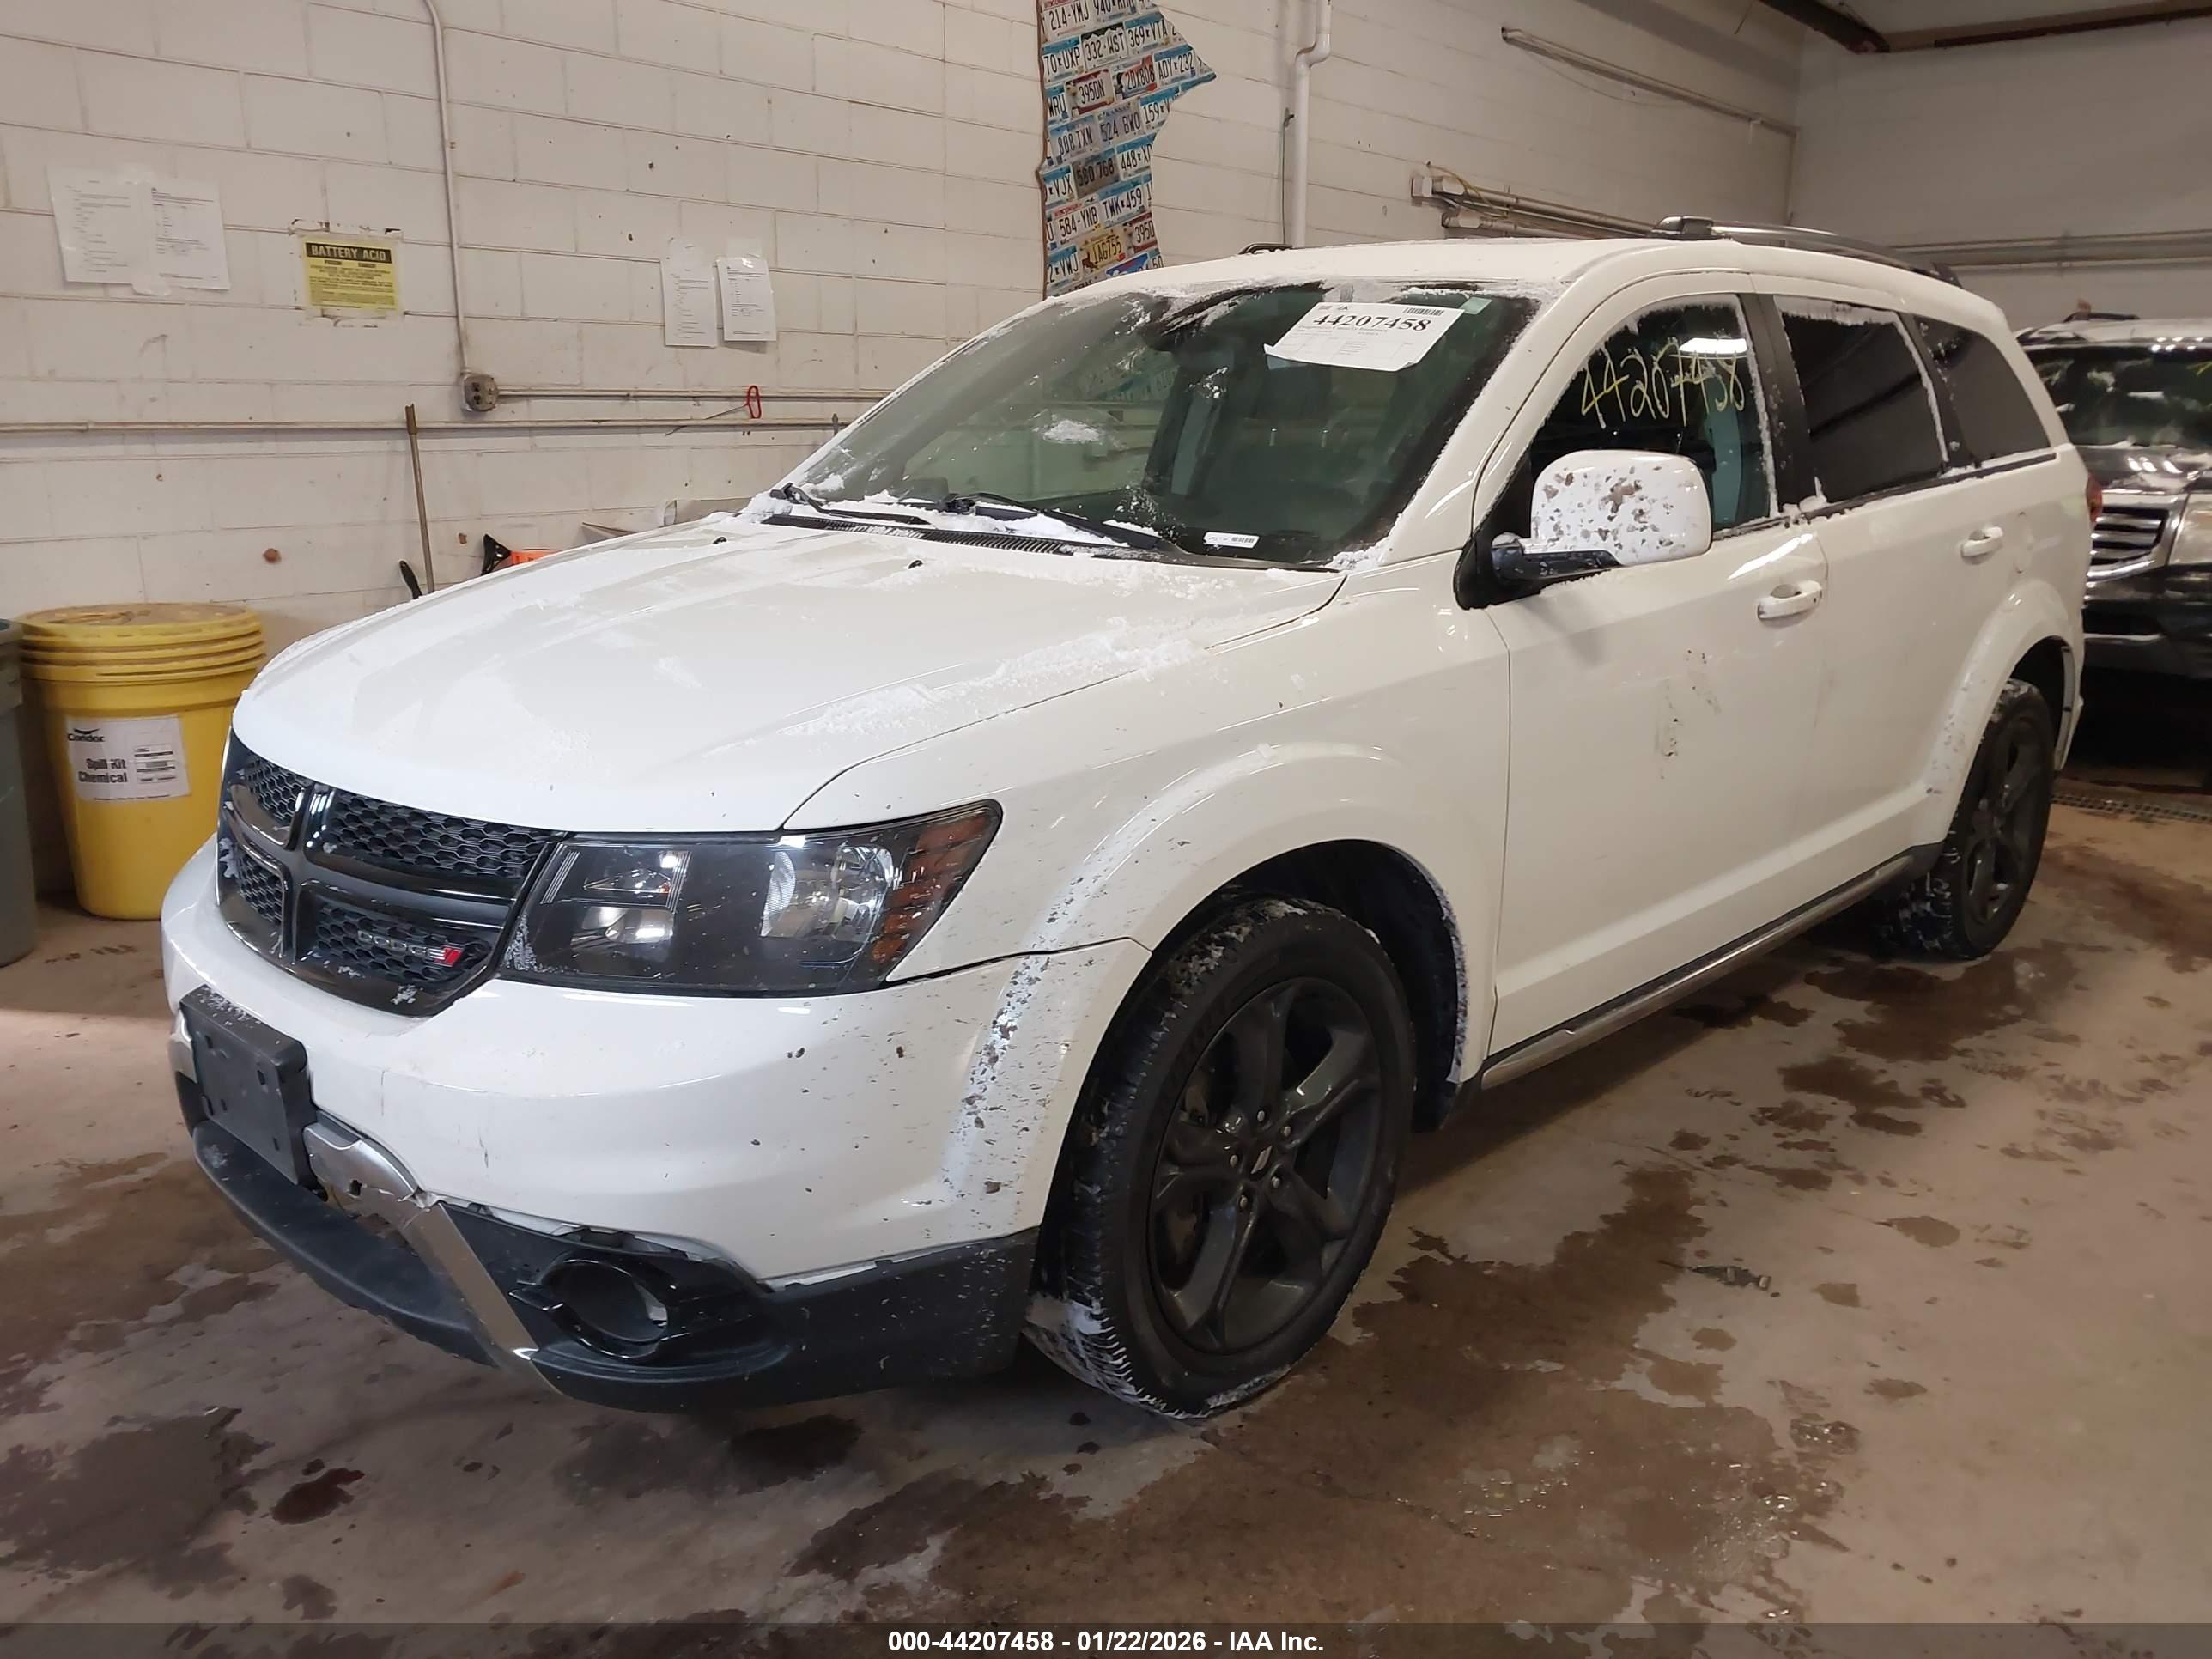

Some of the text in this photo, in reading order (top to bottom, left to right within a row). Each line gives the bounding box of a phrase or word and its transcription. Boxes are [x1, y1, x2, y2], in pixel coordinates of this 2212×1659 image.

[311, 245, 386, 261] BATTERY ACID
[1313, 314, 1431, 331] 44207458
[68, 733, 105, 743] Condor
[86, 758, 107, 770] Spill
[110, 758, 127, 769] Kit
[78, 771, 128, 783] Chemical
[357, 930, 447, 962] DODGE
